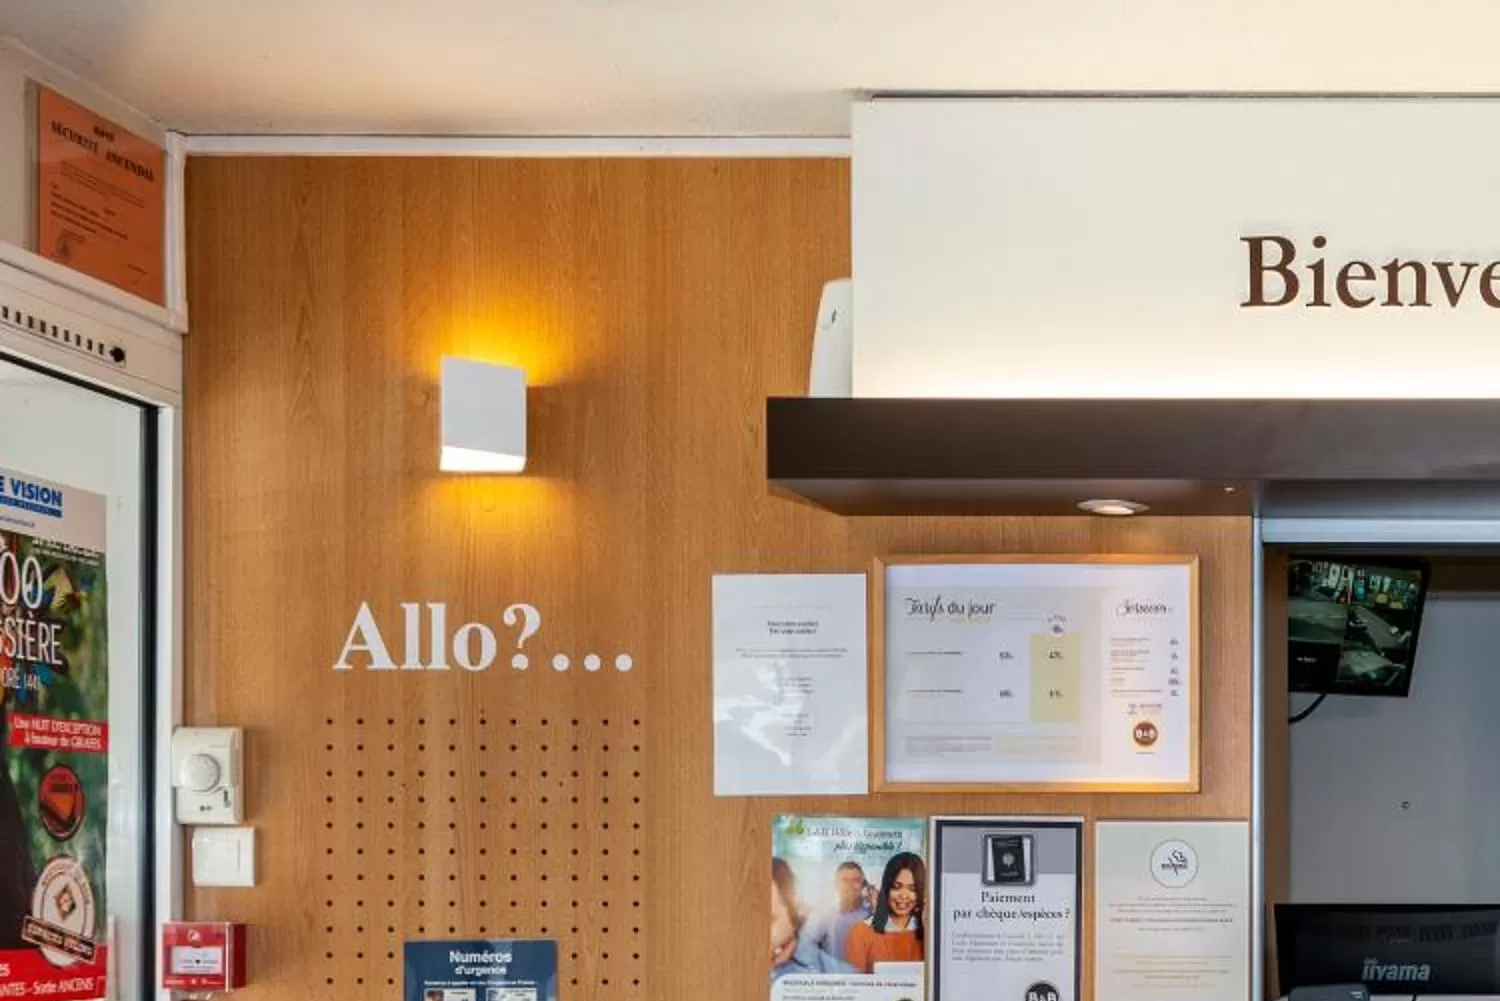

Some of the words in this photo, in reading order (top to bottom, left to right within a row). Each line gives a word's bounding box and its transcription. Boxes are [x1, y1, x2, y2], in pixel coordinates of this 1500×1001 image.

[10, 478, 63, 506] VISION
[0, 610, 63, 665] SIÈRE
[980, 891, 1036, 903] Paiement
[952, 908, 972, 921] par
[449, 950, 513, 963] Numéros
[455, 965, 508, 977] d'urgence
[1361, 957, 1431, 981] iiyama
